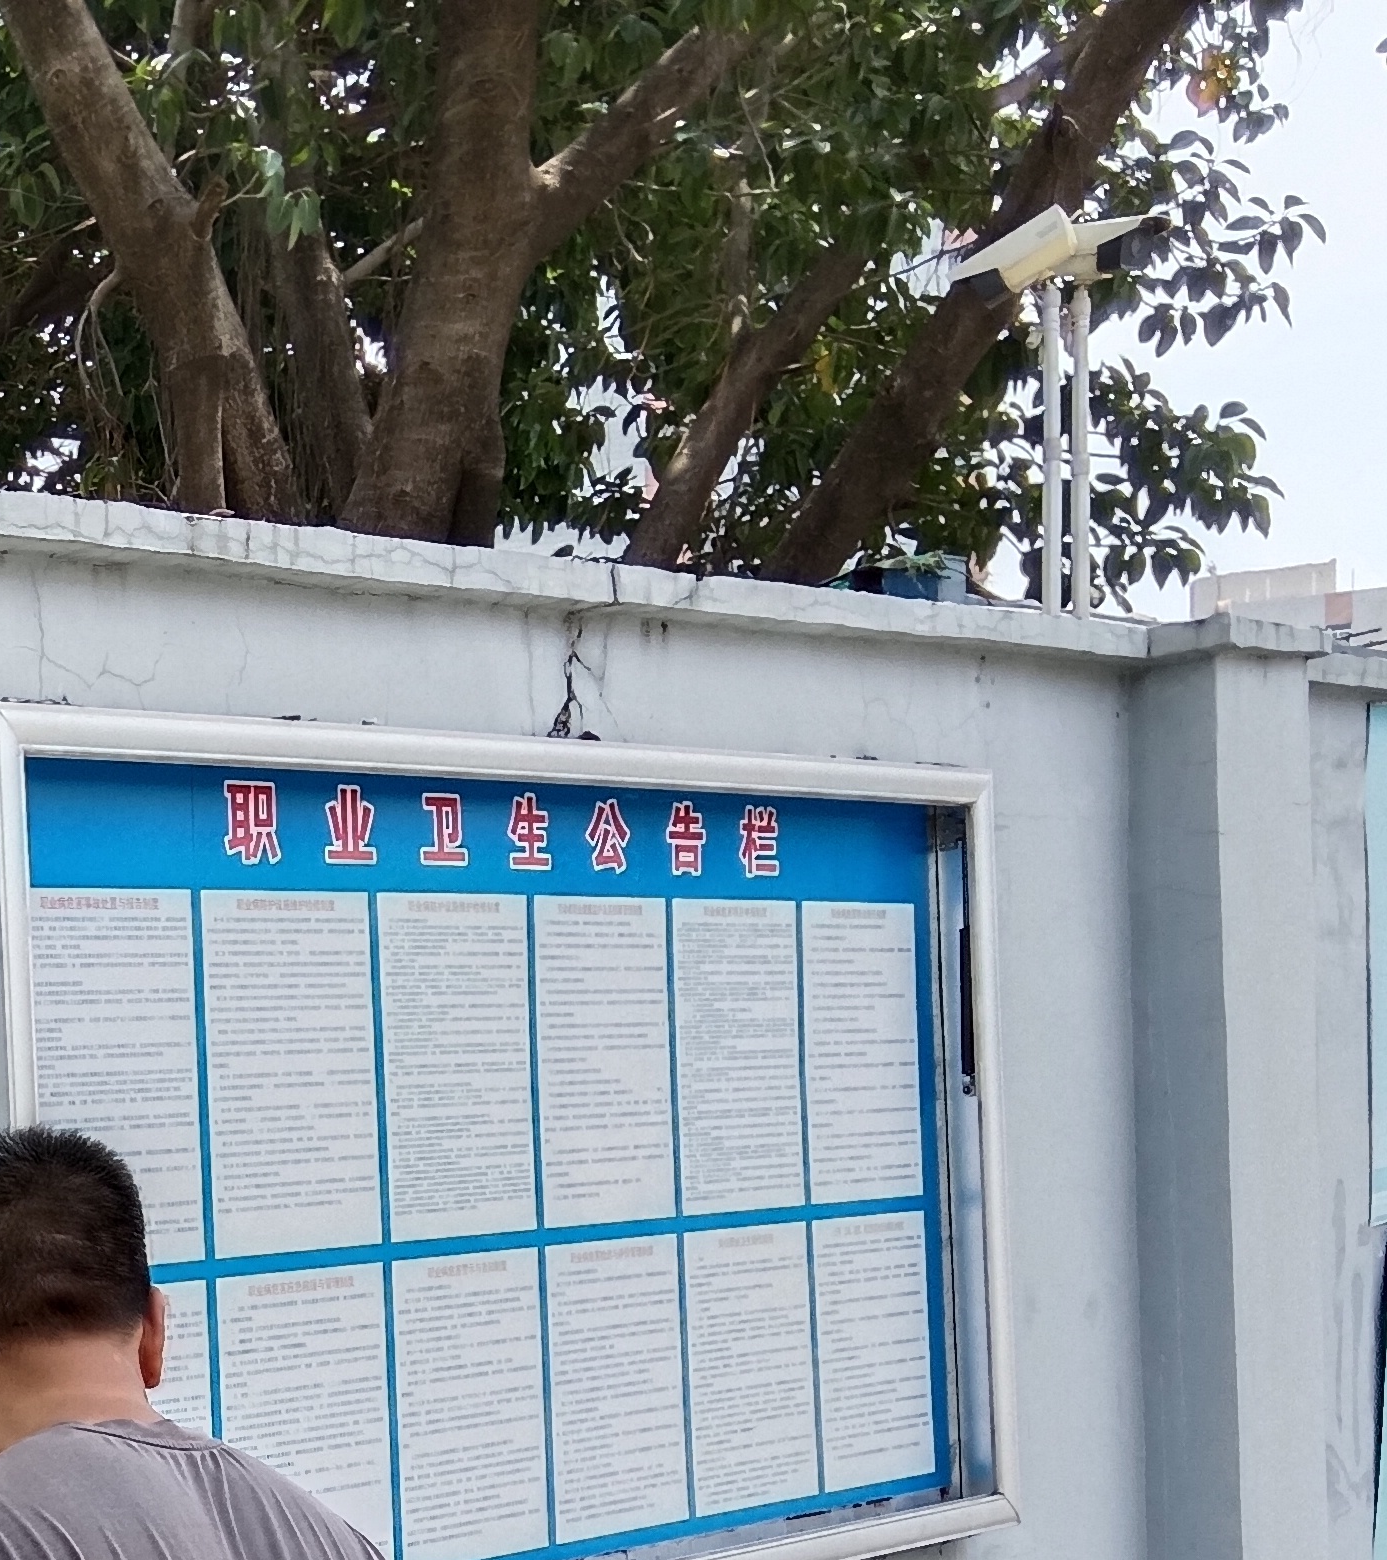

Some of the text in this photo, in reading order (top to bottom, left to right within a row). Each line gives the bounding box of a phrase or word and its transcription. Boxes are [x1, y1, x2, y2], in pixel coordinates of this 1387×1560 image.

[224, 780, 781, 877] 职业卫生公告栏
